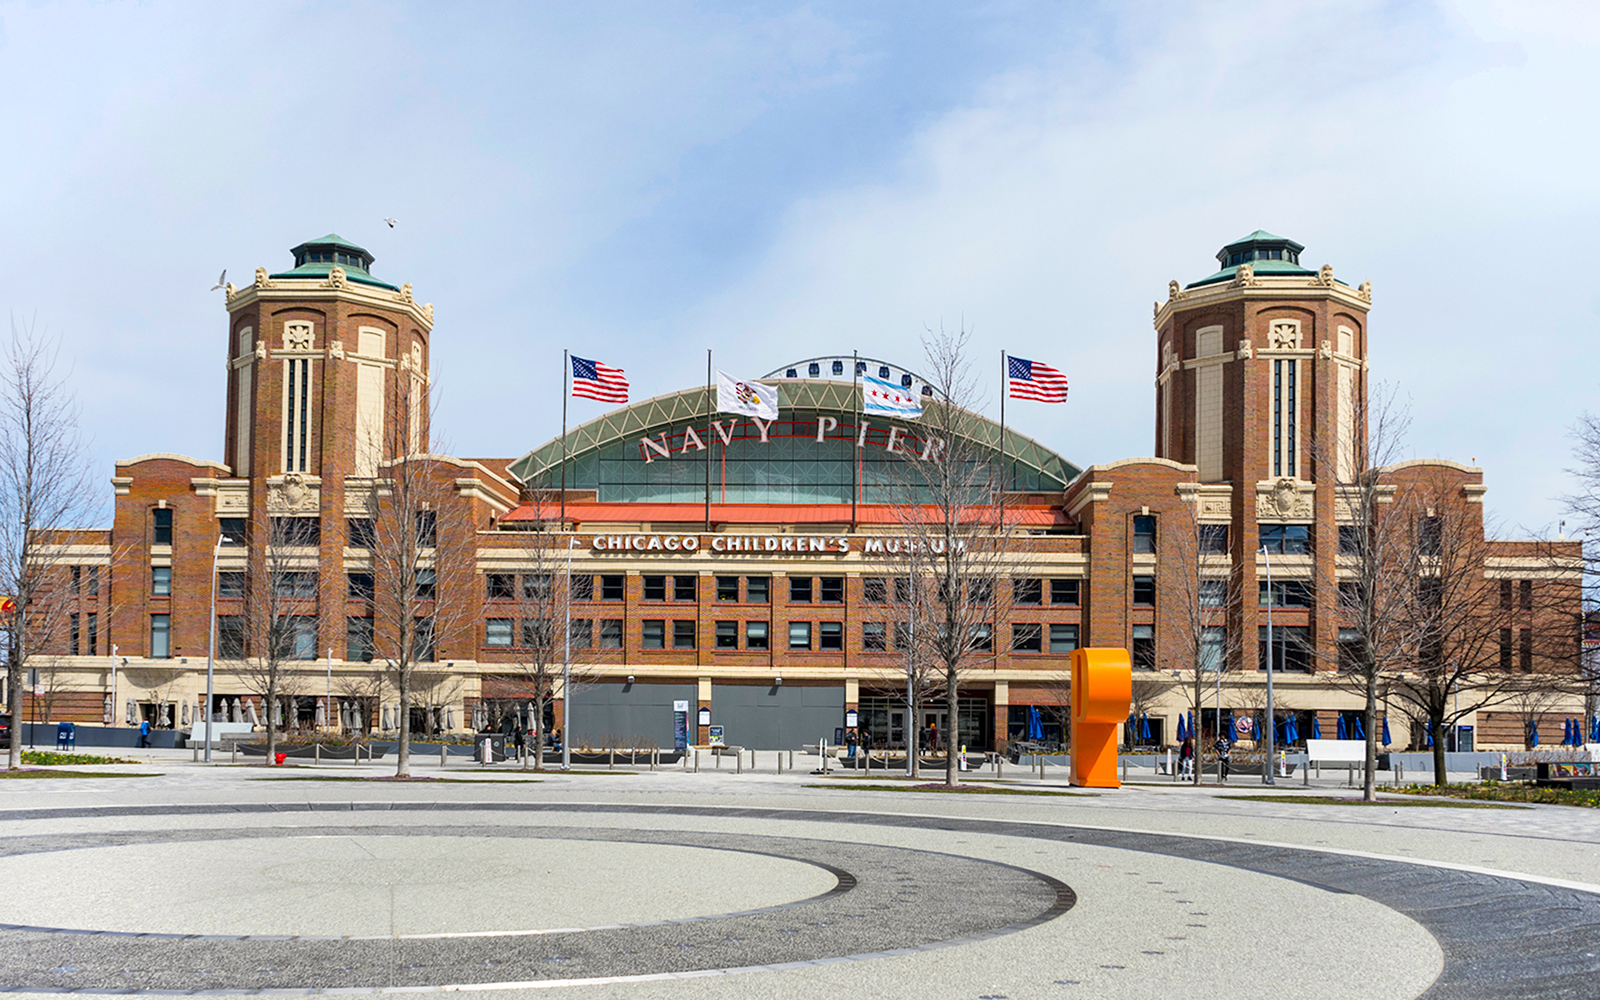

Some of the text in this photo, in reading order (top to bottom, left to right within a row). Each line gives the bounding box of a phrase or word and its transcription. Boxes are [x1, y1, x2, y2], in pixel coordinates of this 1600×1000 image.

[639, 416, 946, 465] NAVY PIER
[593, 535, 699, 550] CHICAGO
[711, 536, 850, 552] CHILDREN'S
